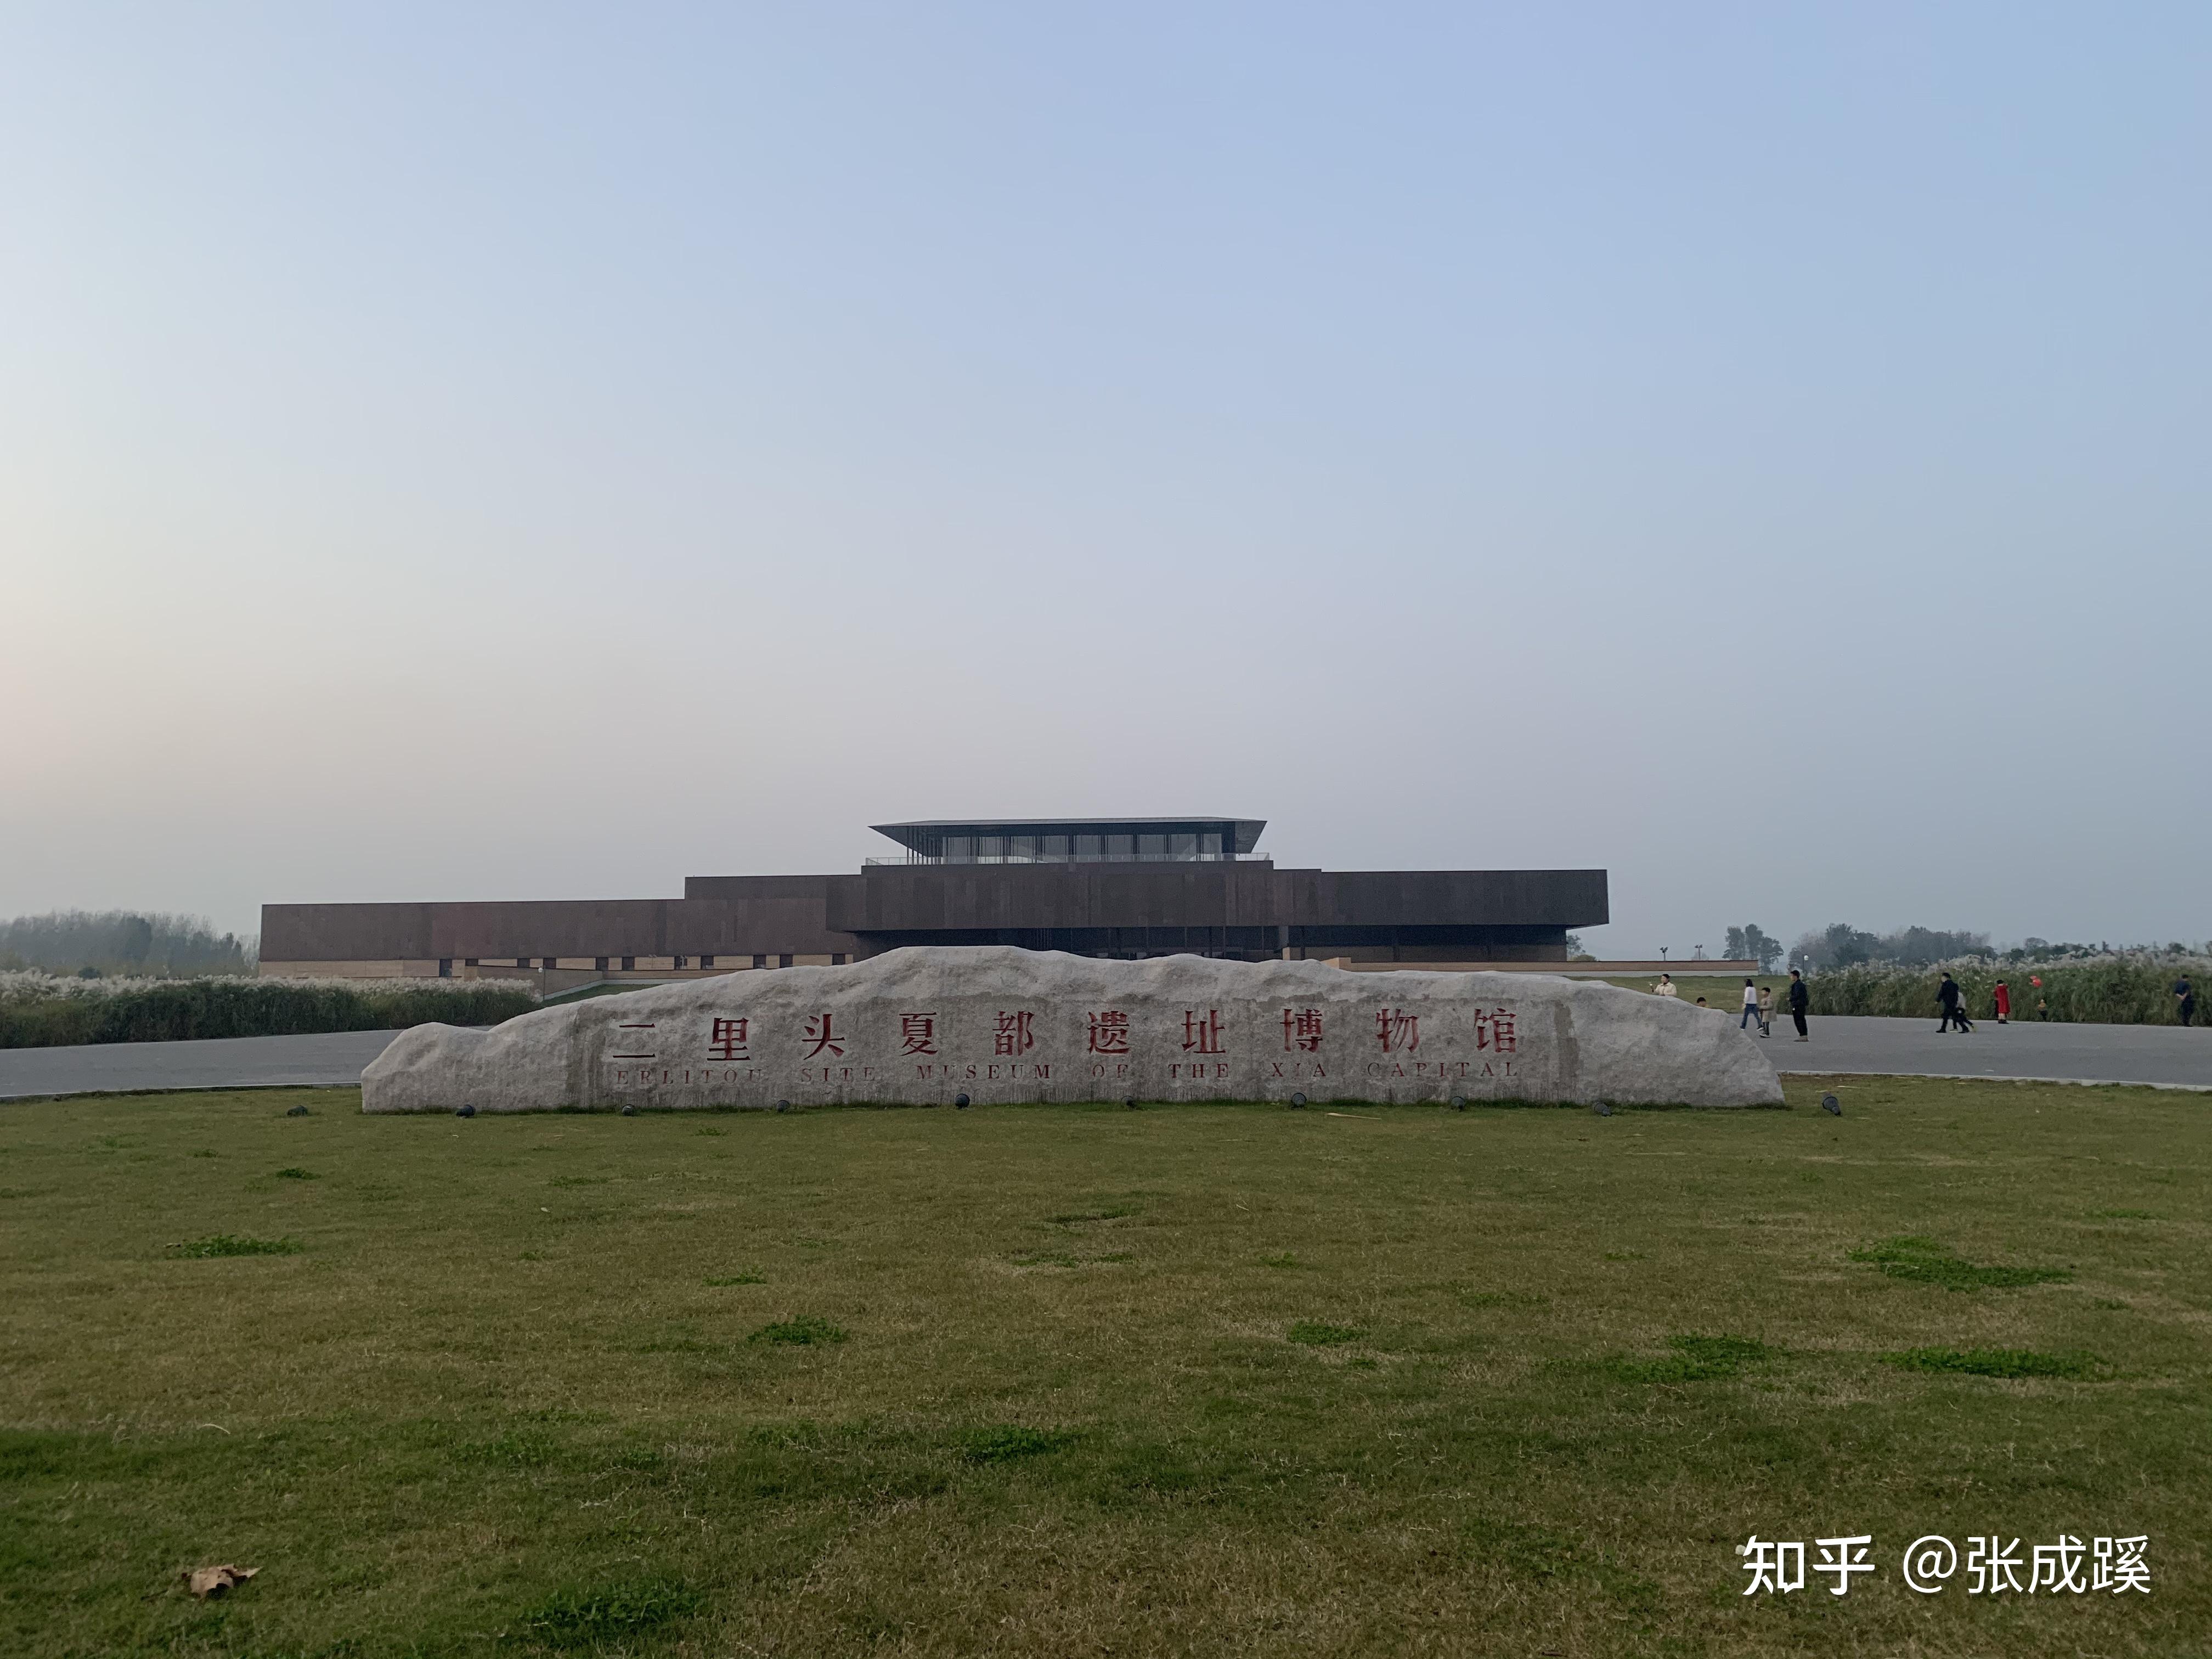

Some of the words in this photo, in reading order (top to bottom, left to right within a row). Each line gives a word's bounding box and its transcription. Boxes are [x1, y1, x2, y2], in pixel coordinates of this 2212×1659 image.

[612, 1008, 1517, 1061] 二里头夏都遗址博物馆
[616, 1068, 764, 1085] ERLITOU
[800, 1067, 876, 1083] SITE
[916, 1064, 1051, 1080] MUSEUM
[1092, 1064, 1128, 1079] OF
[1169, 1063, 1229, 1079] THE
[1271, 1062, 1327, 1077] XIA
[1367, 1062, 1518, 1077] CAPITAL
